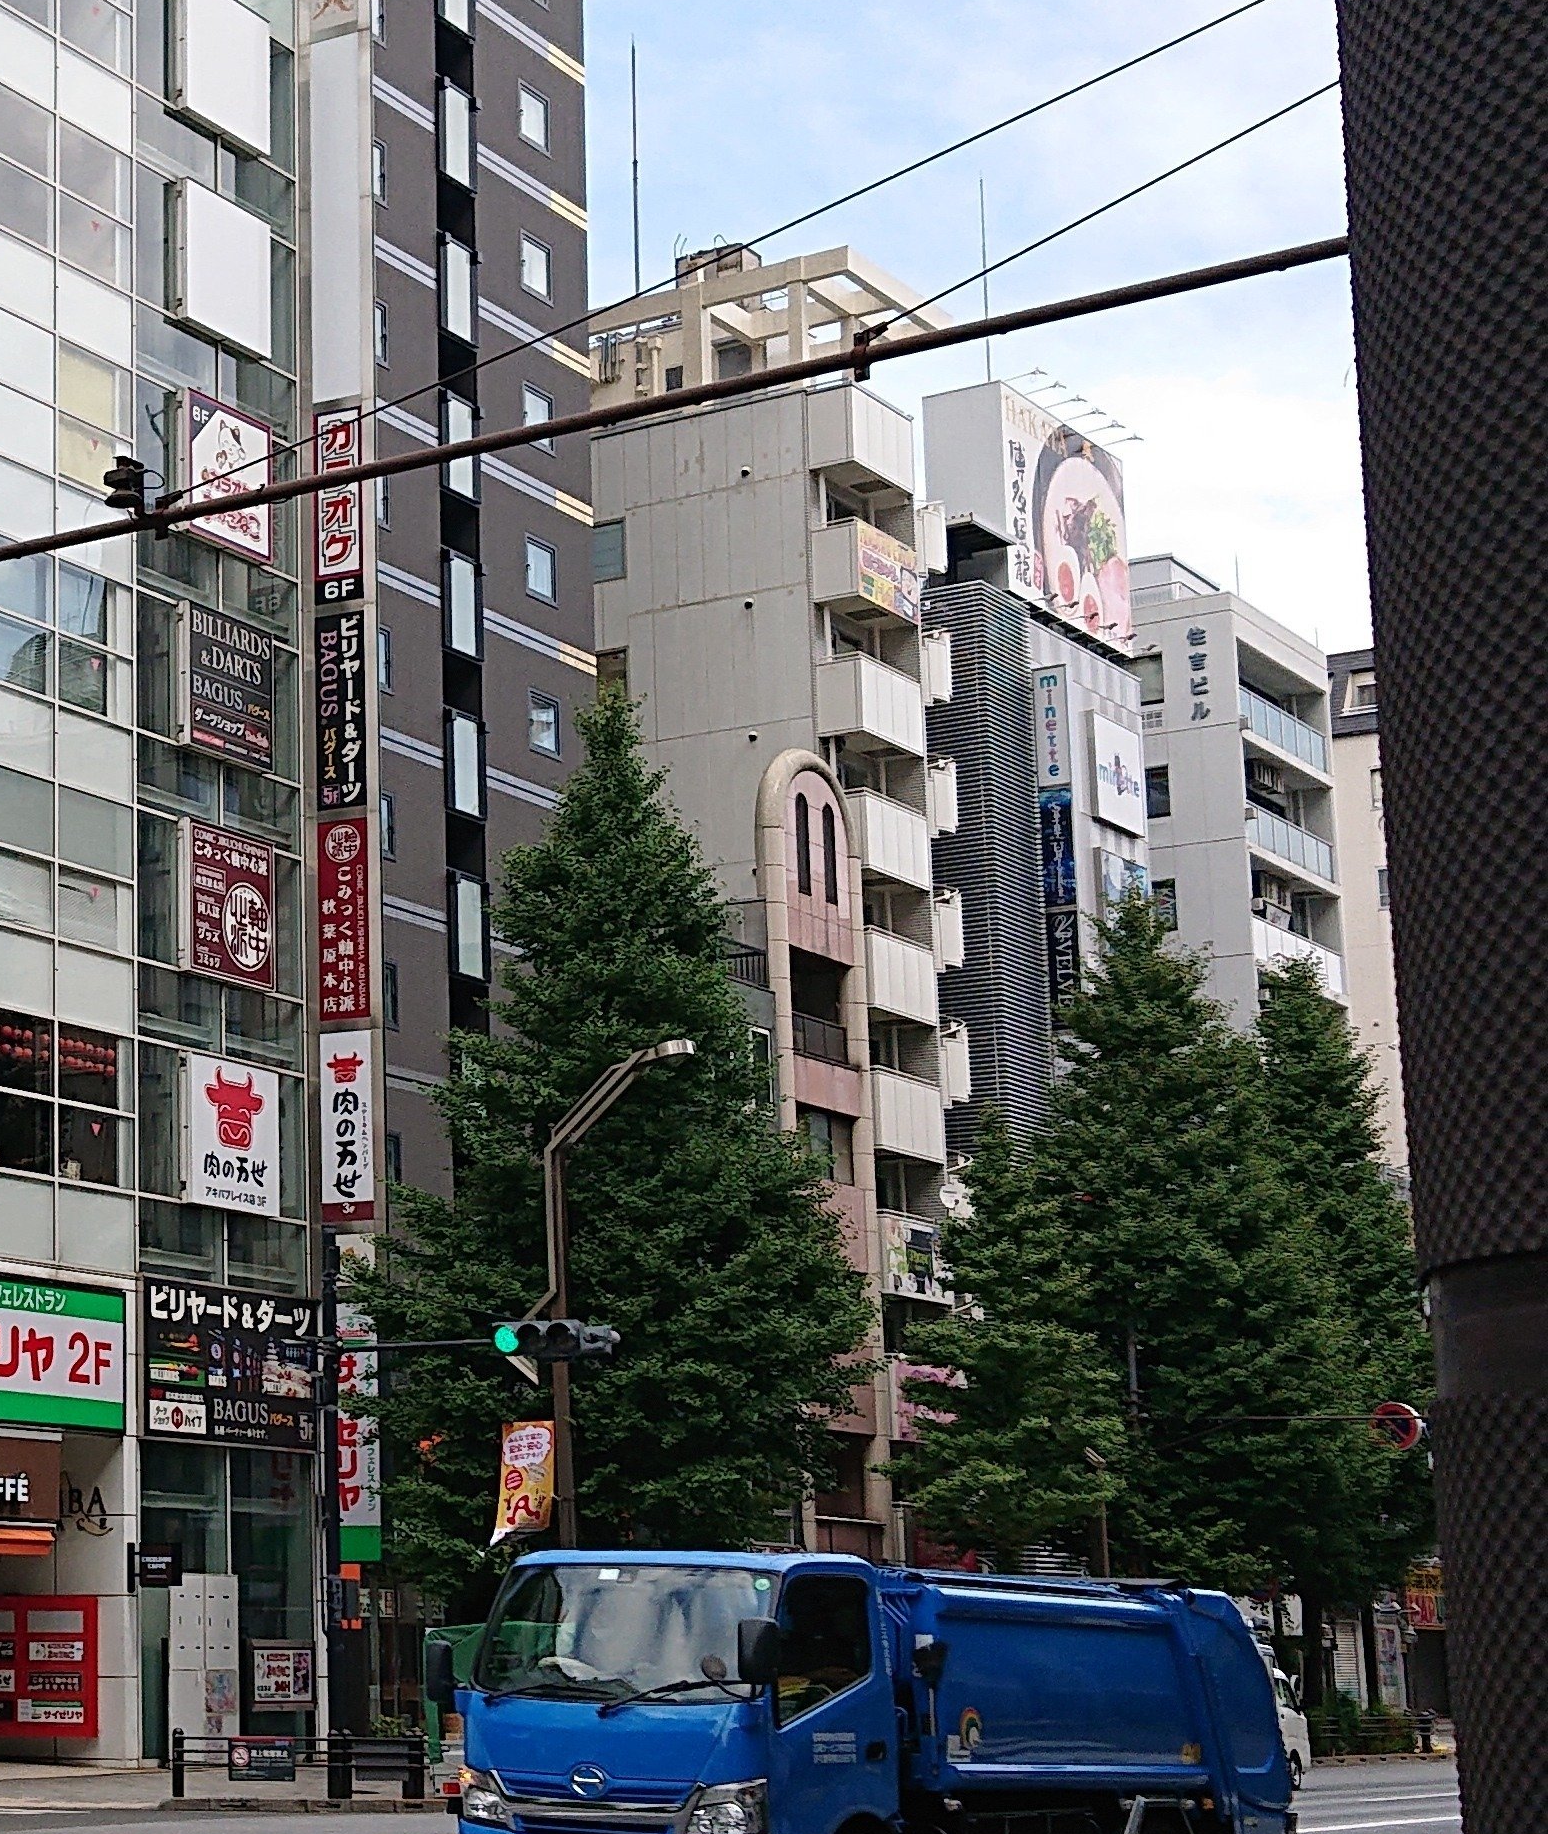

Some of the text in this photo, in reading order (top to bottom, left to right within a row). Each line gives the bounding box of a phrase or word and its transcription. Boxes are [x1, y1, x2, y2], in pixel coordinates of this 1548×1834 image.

[324, 577, 355, 600] 6F
[192, 609, 271, 661] BILLIARDS
[1039, 674, 1060, 777] minette
[332, 1087, 363, 1199] 肉の万世
[203, 1150, 268, 1188] 肉の万世
[68, 1331, 111, 1386] 2F
[213, 1398, 271, 1426] BAGUS
[44, 1709, 83, 1720] サイゼリヤ
